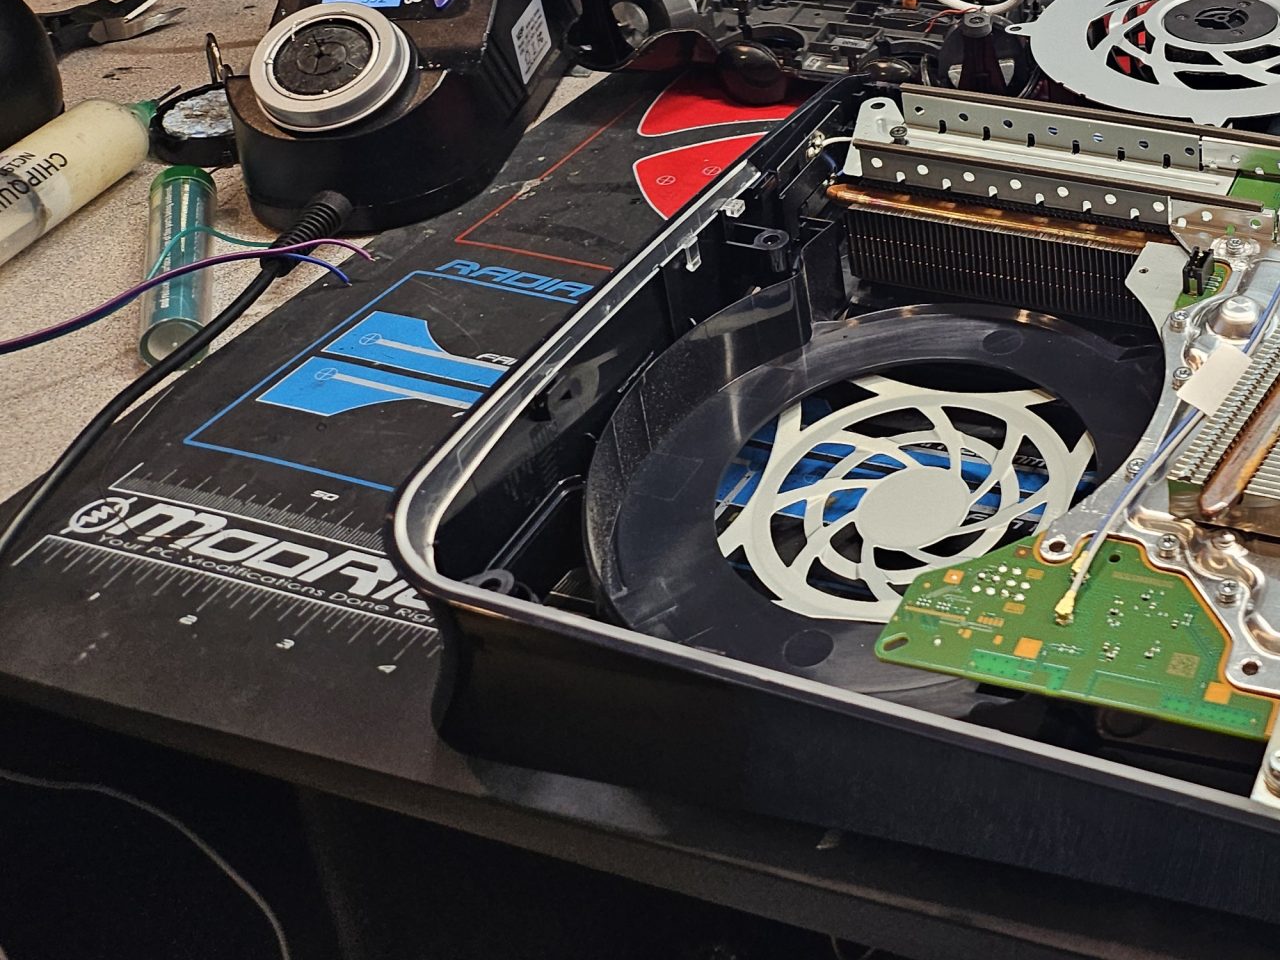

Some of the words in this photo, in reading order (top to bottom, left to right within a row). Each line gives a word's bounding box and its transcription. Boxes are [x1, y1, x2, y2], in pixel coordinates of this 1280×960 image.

[434, 259, 595, 297] RADIA
[310, 489, 340, 502] 50
[99, 534, 145, 551] Your
[147, 546, 174, 559] PC
[181, 554, 326, 597] Modifications
[328, 592, 389, 613] Done
[178, 614, 198, 625] 2
[275, 638, 295, 650] 3
[377, 664, 397, 674] 4
